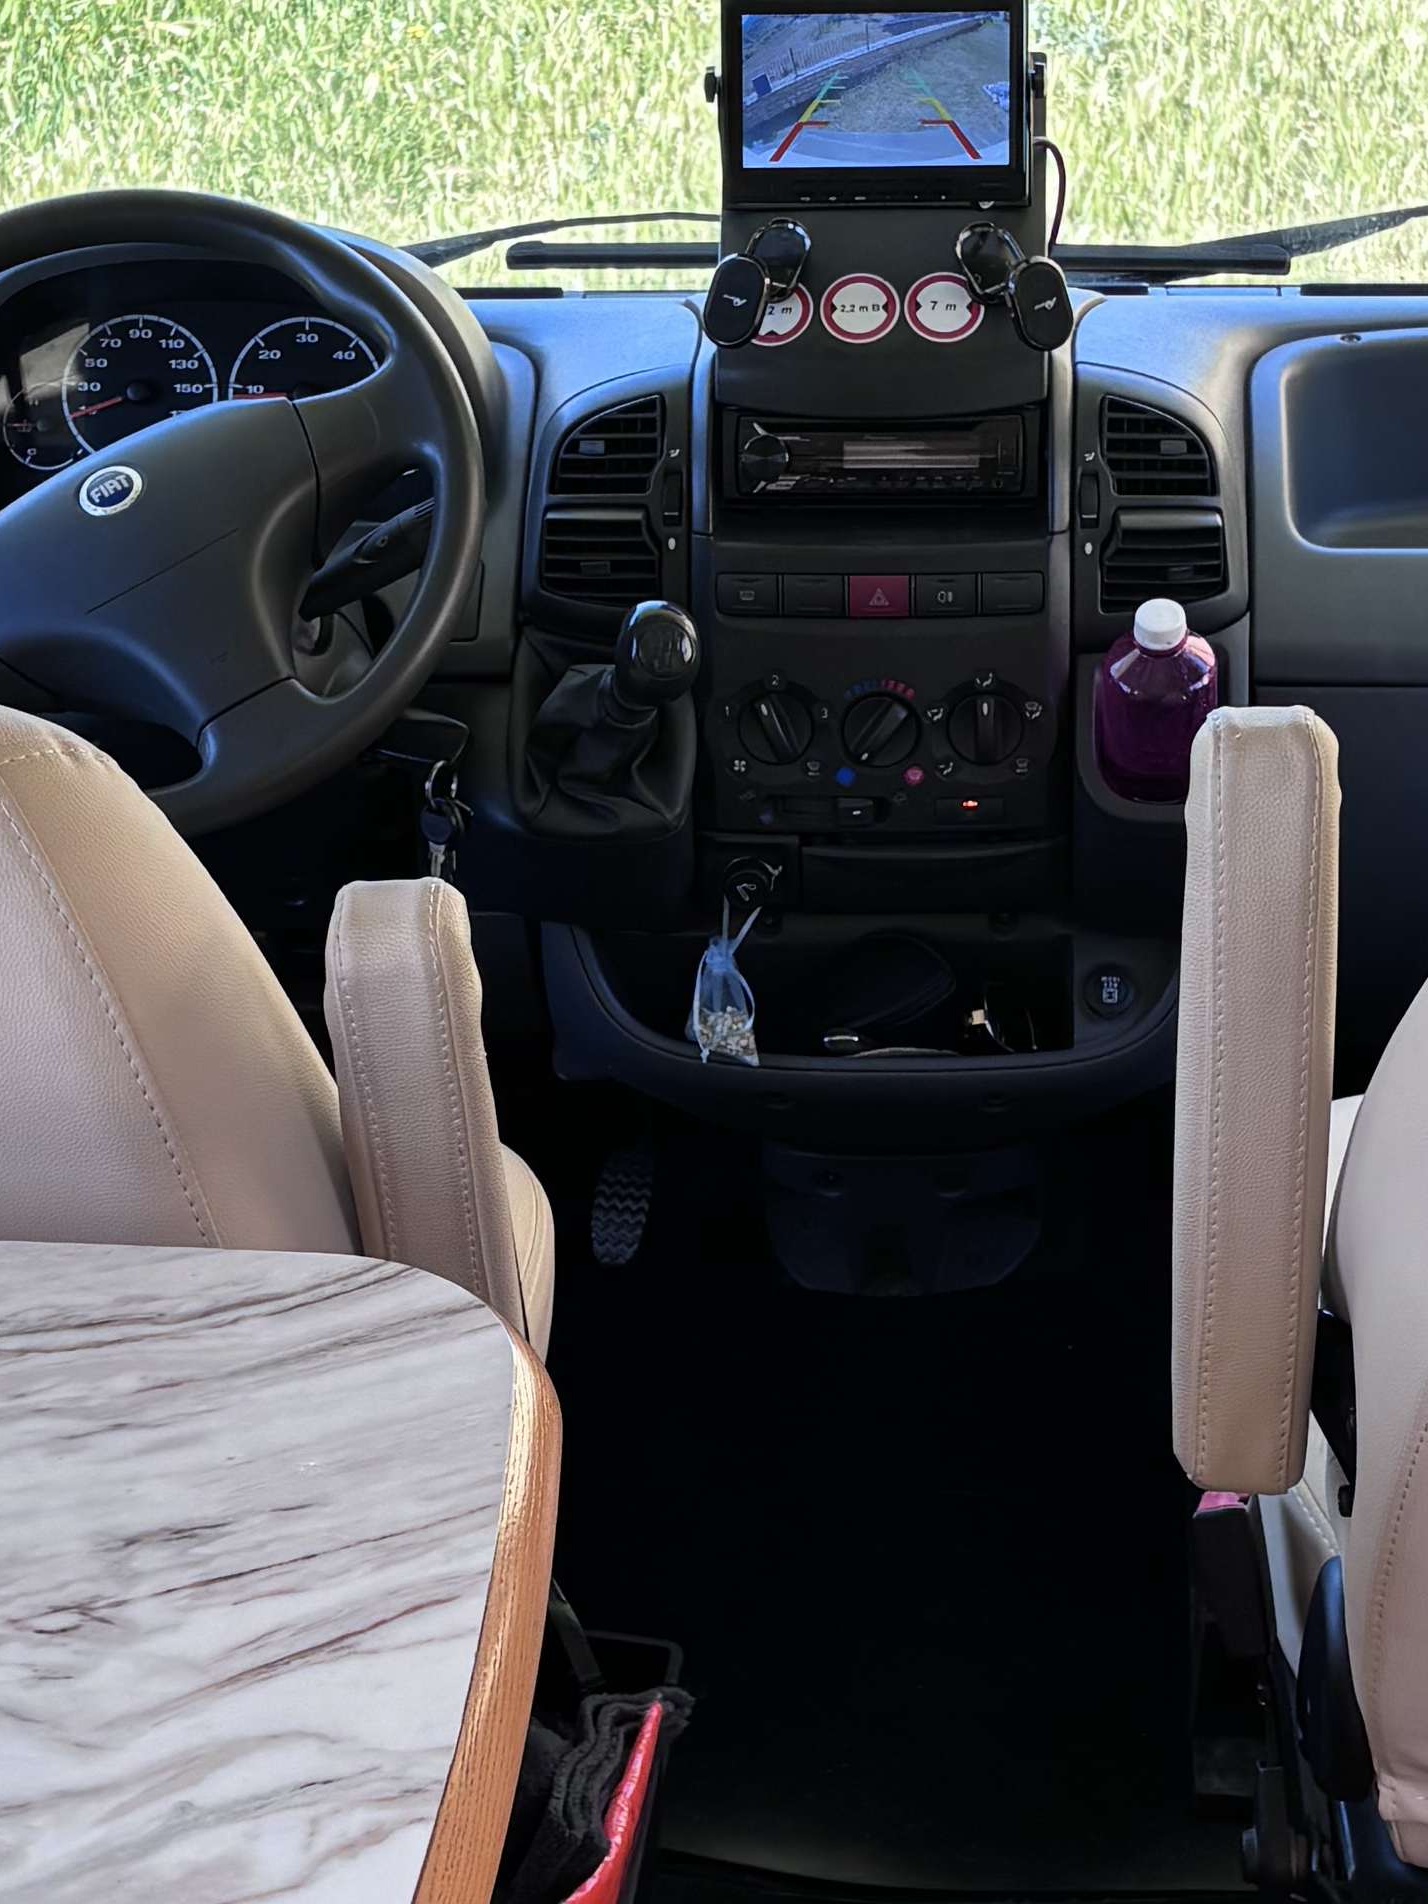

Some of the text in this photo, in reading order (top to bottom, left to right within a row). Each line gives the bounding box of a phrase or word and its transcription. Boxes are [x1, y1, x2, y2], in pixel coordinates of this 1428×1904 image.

[781, 306, 792, 315] m
[930, 300, 956, 312] 7 m
[128, 328, 153, 339] 90
[295, 333, 319, 343] 30
[99, 338, 122, 348] 70
[158, 339, 185, 349] 110
[258, 350, 281, 360] 20
[332, 350, 356, 360] 40
[84, 358, 108, 368] 50
[168, 359, 199, 369] 130
[77, 382, 101, 392] 30
[173, 384, 203, 394] 150
[245, 384, 265, 394] 10
[88, 474, 130, 503] FIAT
[771, 674, 779, 686] 2
[821, 706, 828, 719] 3
